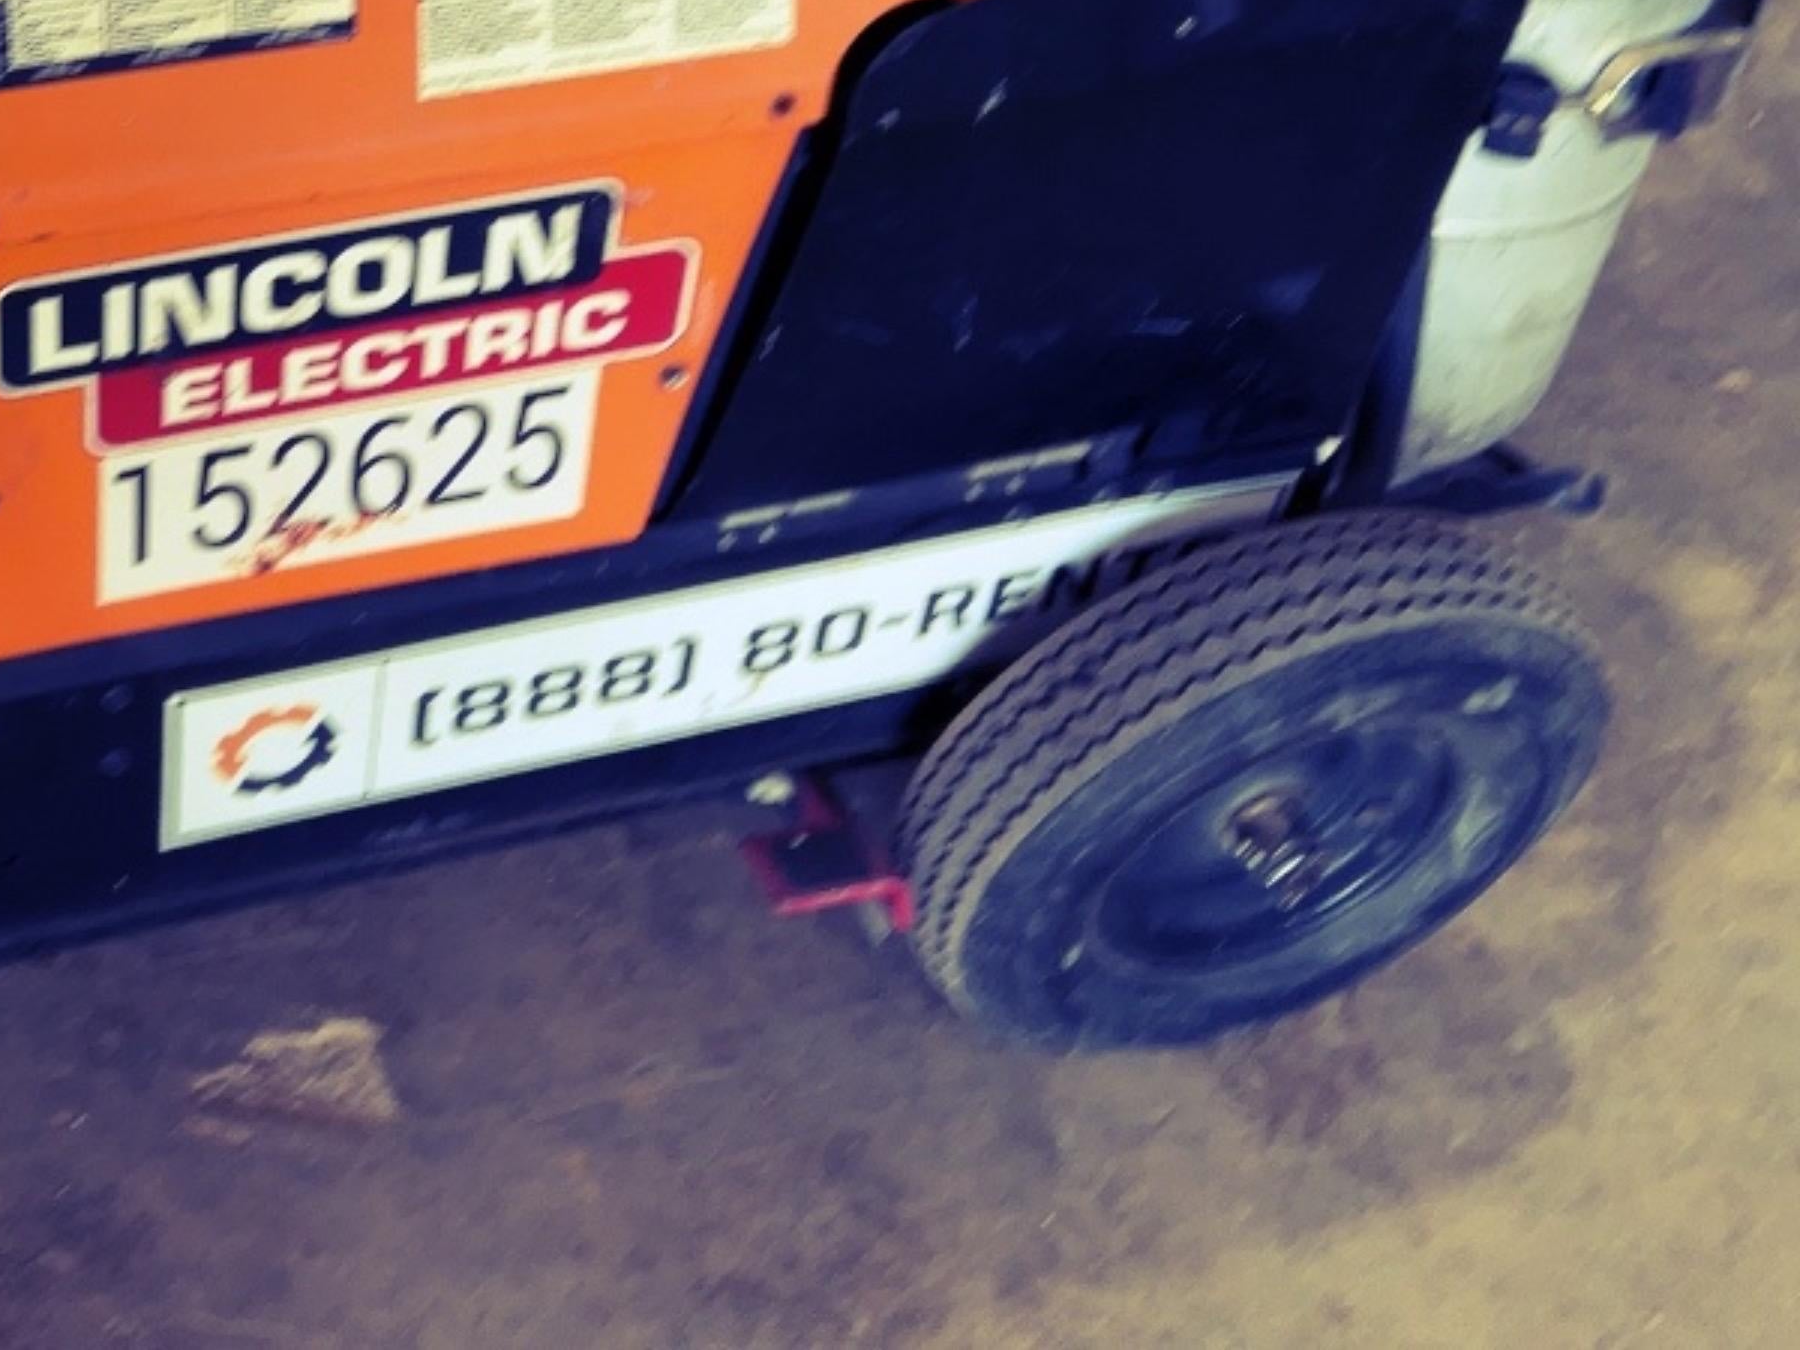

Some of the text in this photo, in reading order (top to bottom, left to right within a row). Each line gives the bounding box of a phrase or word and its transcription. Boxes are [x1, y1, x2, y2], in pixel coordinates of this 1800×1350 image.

[26, 201, 587, 376] LINCOLN
[158, 288, 632, 430] ELECTRIC
[111, 382, 573, 566] 152625
[408, 636, 698, 746] (888)
